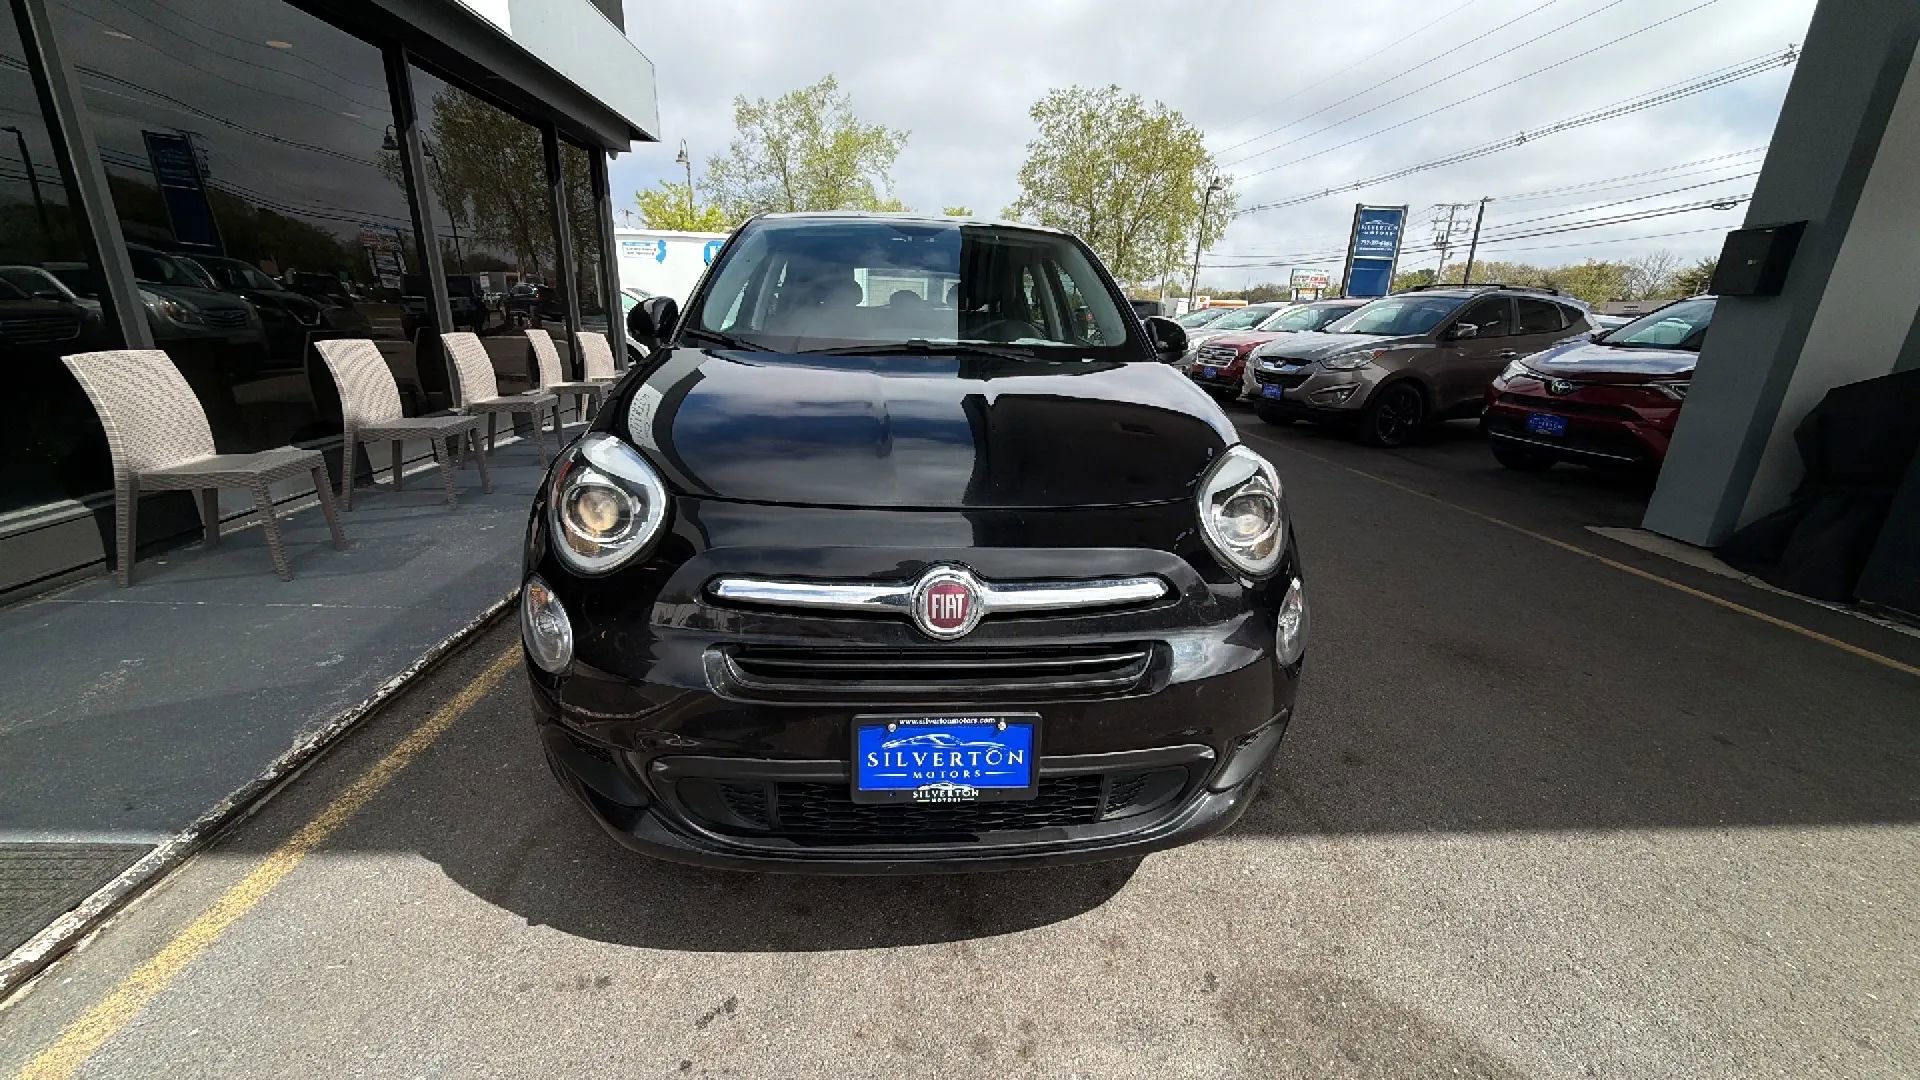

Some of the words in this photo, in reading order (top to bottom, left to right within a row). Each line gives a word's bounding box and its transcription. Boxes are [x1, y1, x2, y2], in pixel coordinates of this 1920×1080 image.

[932, 593, 965, 619] FIAT
[899, 717, 995, 725] www.silvertonmotors.com
[867, 750, 1024, 767] SILVERTON
[912, 769, 981, 779] MOTORS
[912, 789, 979, 799] SILVERTON
